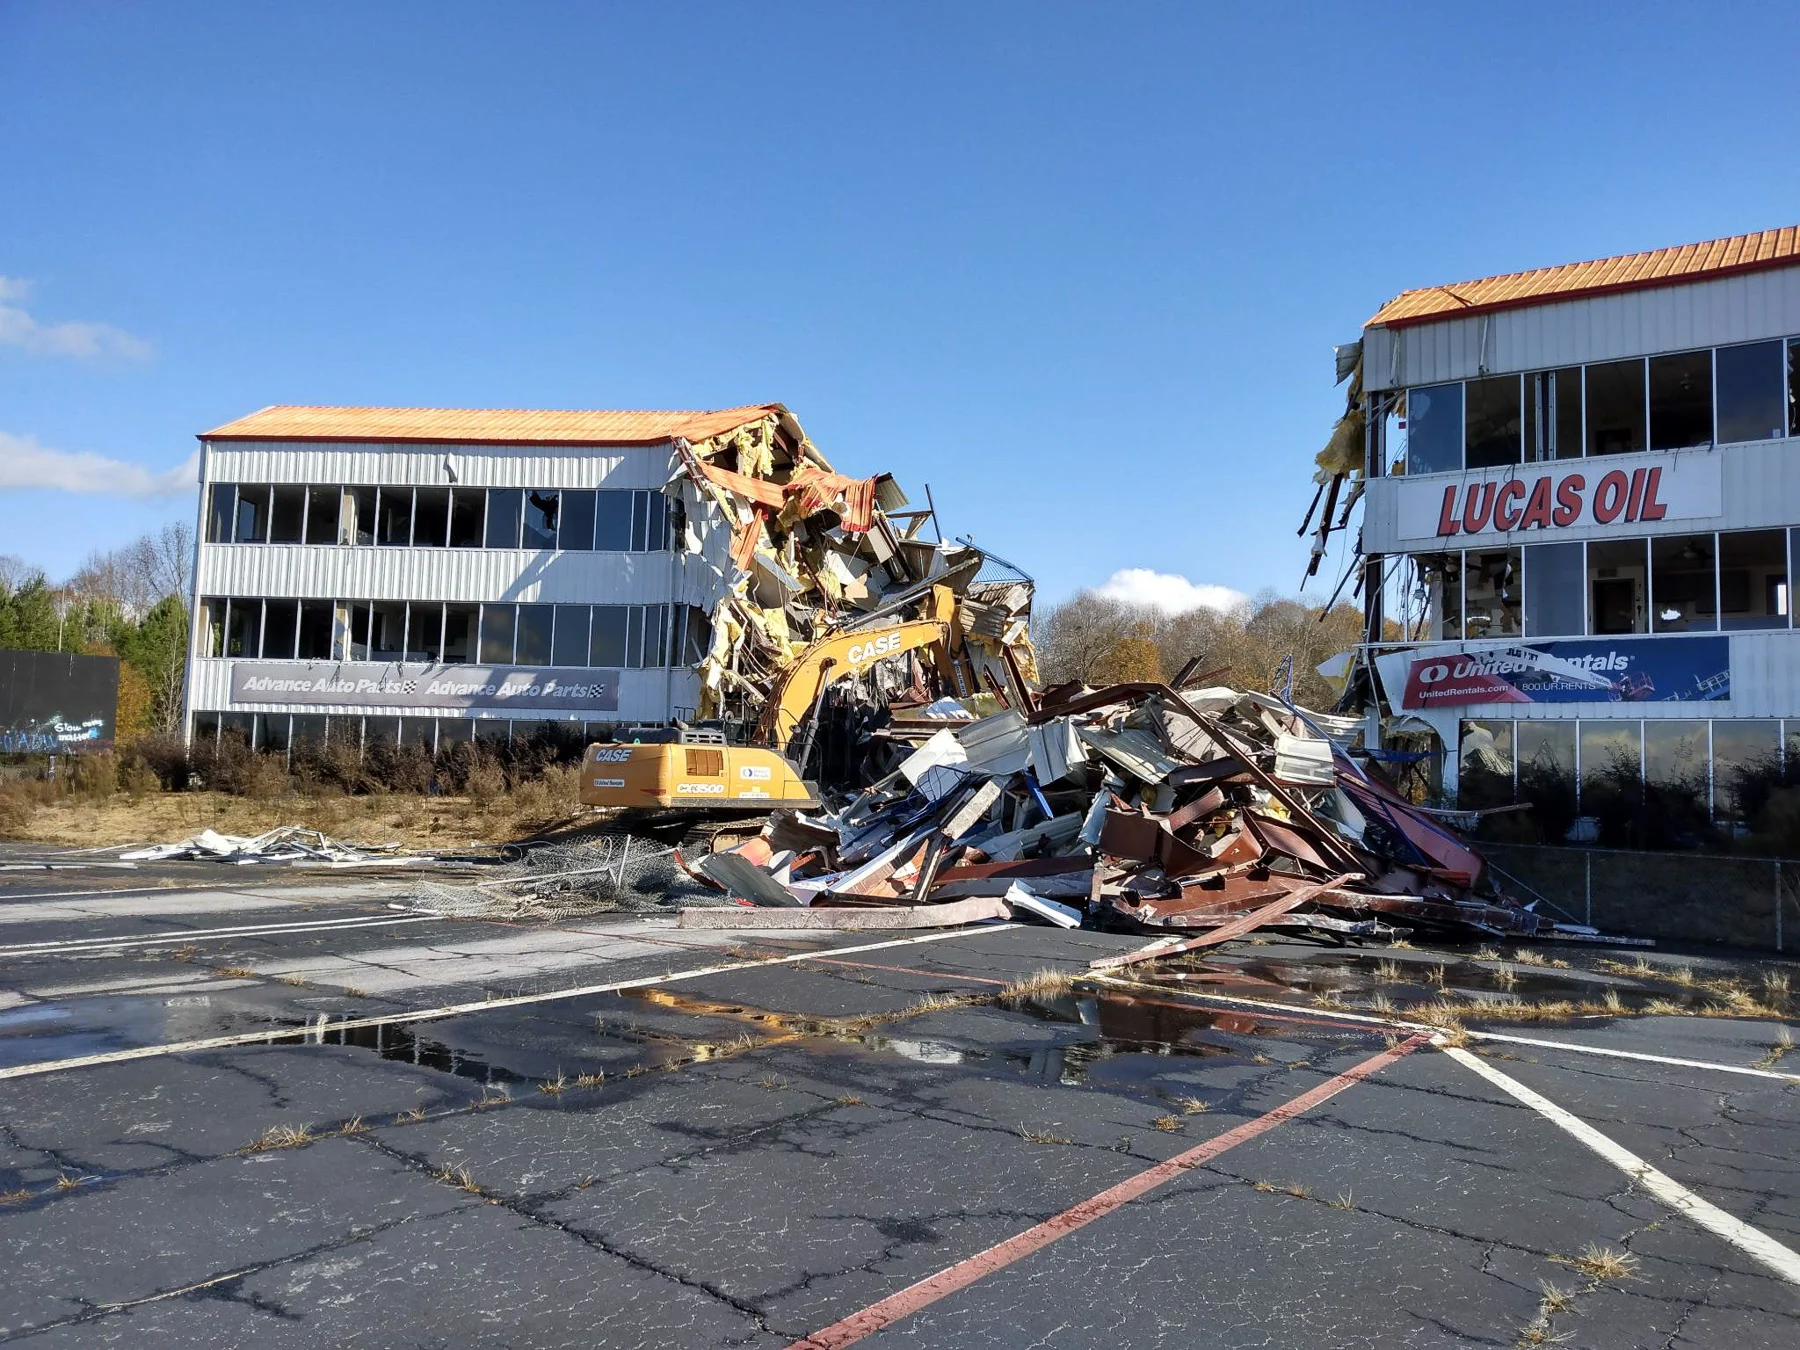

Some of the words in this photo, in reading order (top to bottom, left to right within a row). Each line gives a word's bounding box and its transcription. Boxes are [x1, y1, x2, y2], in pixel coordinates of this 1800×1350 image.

[1436, 474, 1585, 537] LUCAS
[1593, 467, 1667, 524] OIL
[848, 632, 900, 664] CASE
[1453, 656, 1528, 679] United
[242, 677, 311, 692] Advance
[312, 678, 355, 693] Auto
[356, 679, 401, 694] Parts
[425, 681, 496, 696] Advance
[496, 682, 539, 697] Auto
[540, 682, 588, 698] Parts
[1419, 685, 1508, 699] UnitedRentals.com
[595, 749, 633, 762] CASE
